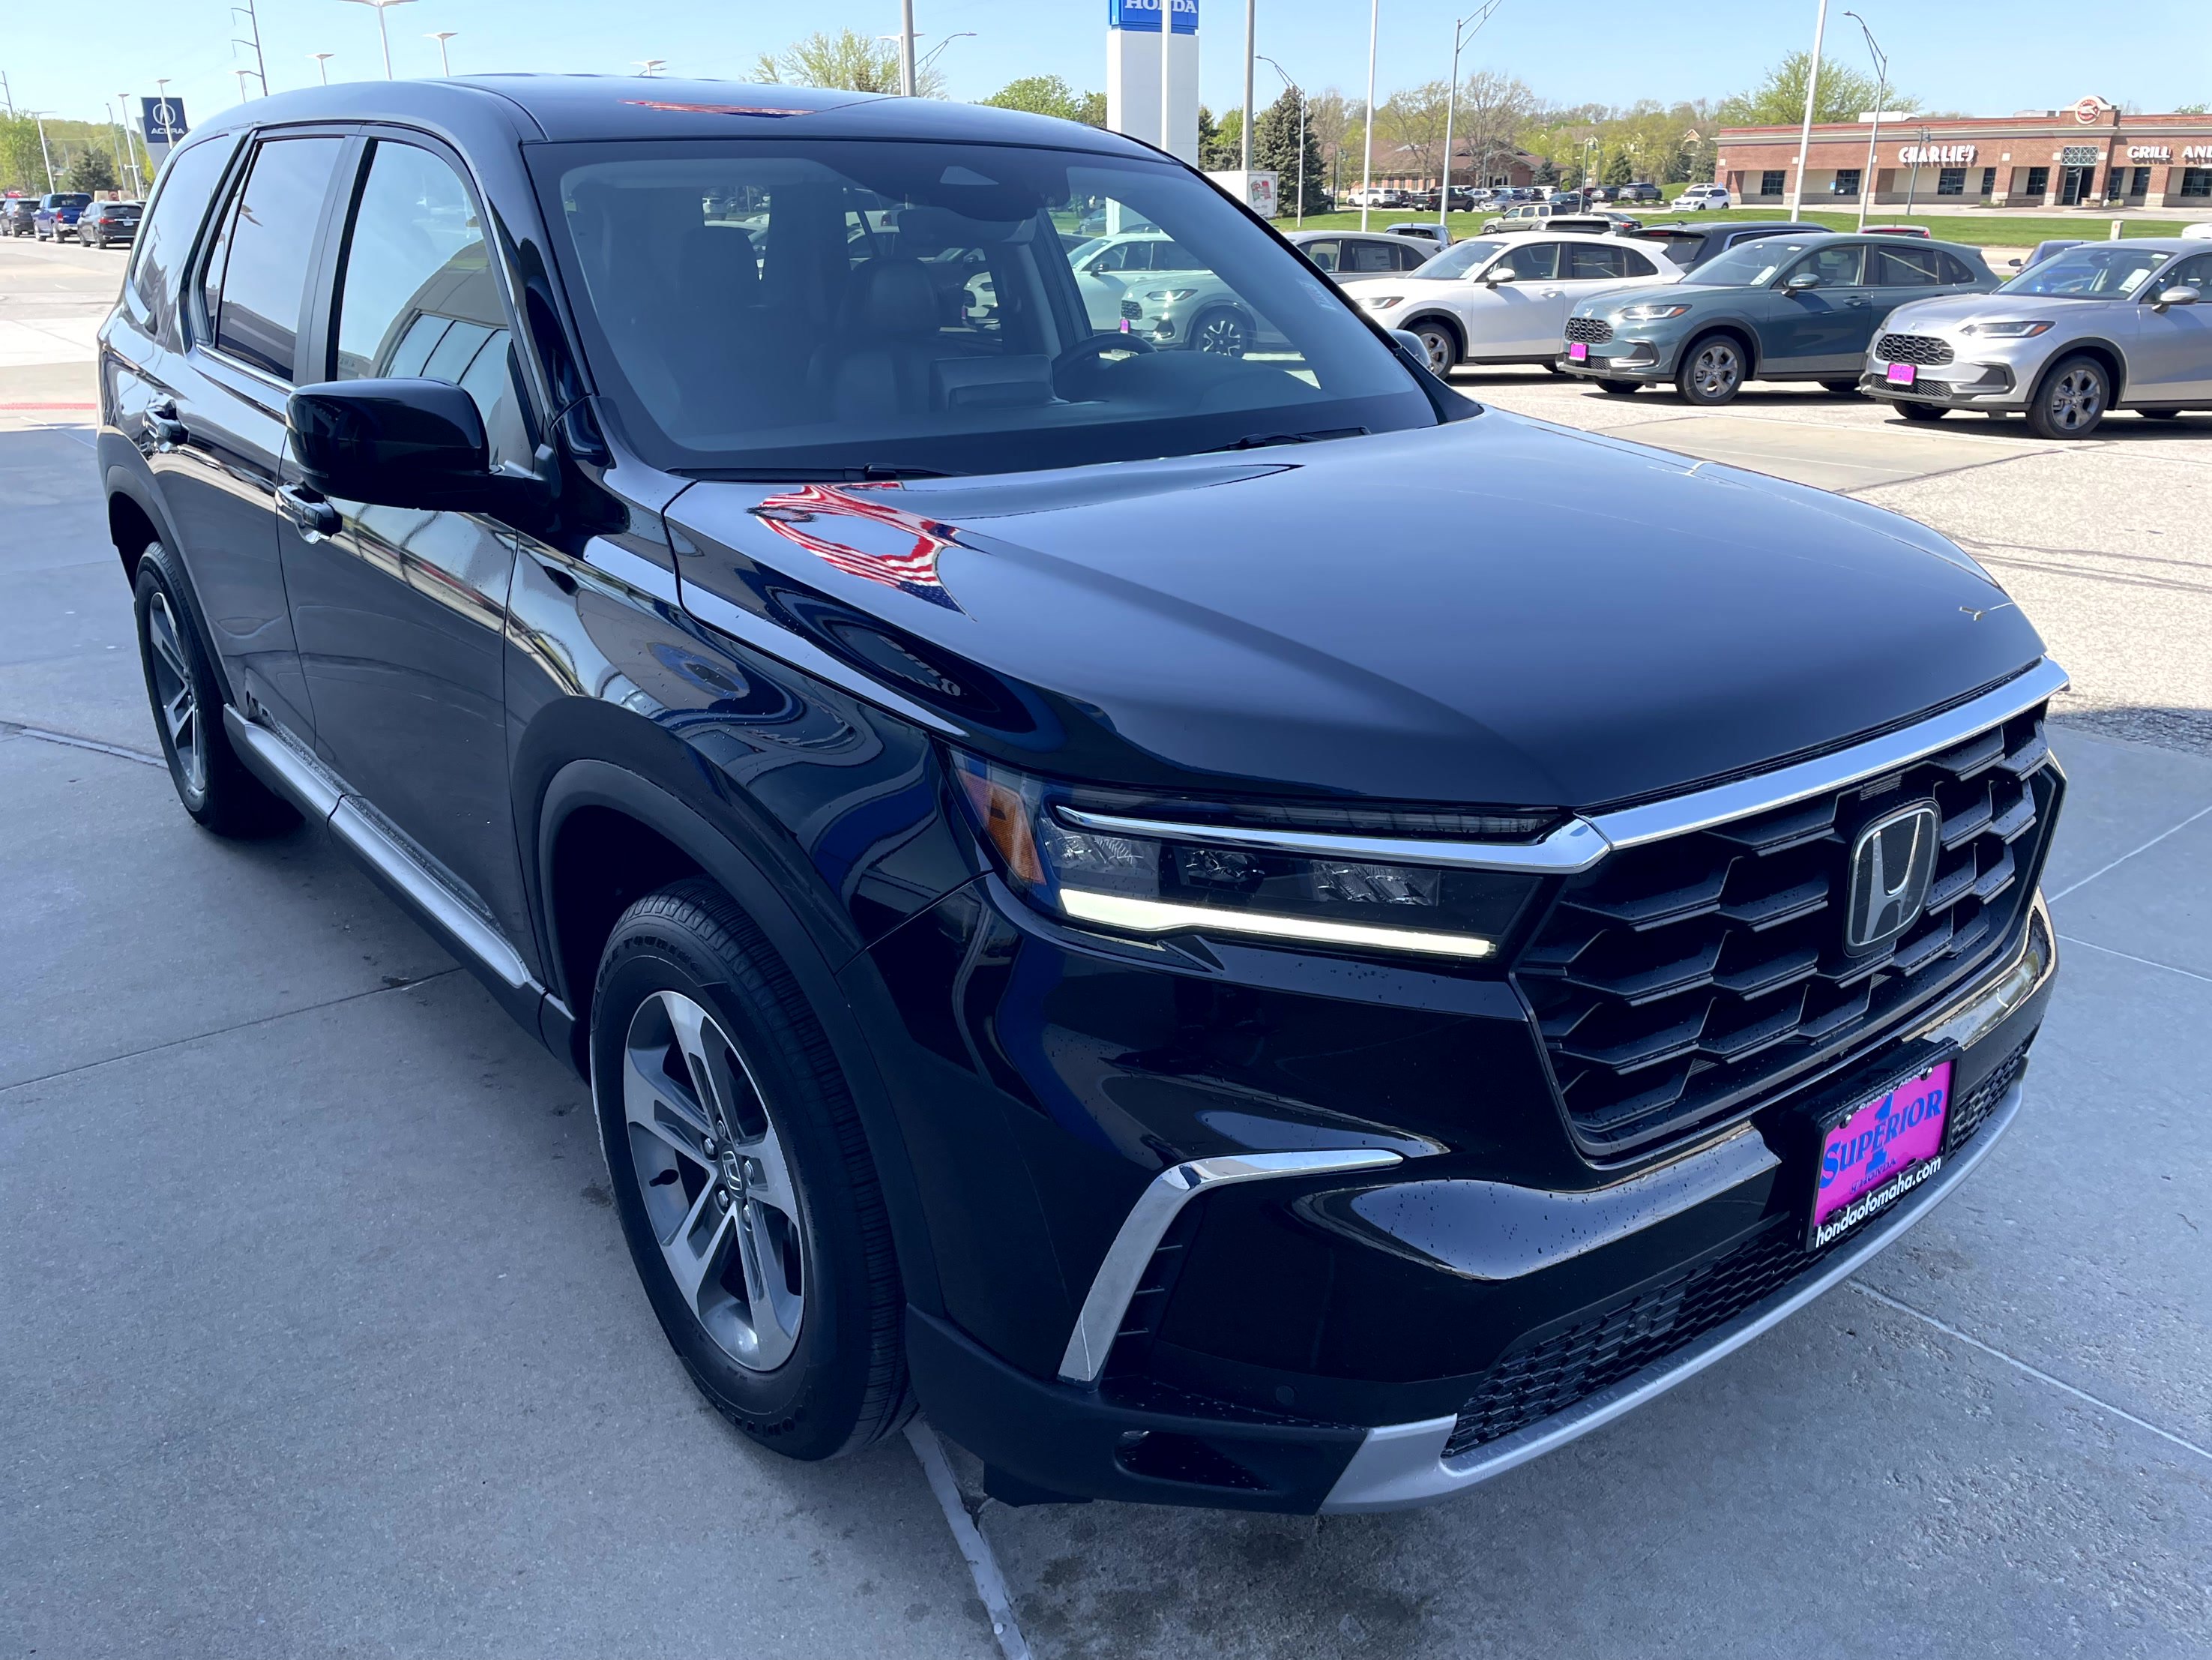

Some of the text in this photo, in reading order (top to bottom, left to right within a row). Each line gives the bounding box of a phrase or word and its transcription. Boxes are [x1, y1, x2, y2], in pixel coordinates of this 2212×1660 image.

[1125, 0, 1198, 13] HODA
[1898, 145, 1976, 163] CHARLIE'S
[2127, 145, 2171, 159] GRILL
[1815, 1156, 1942, 1248] hondaofomaha.com
